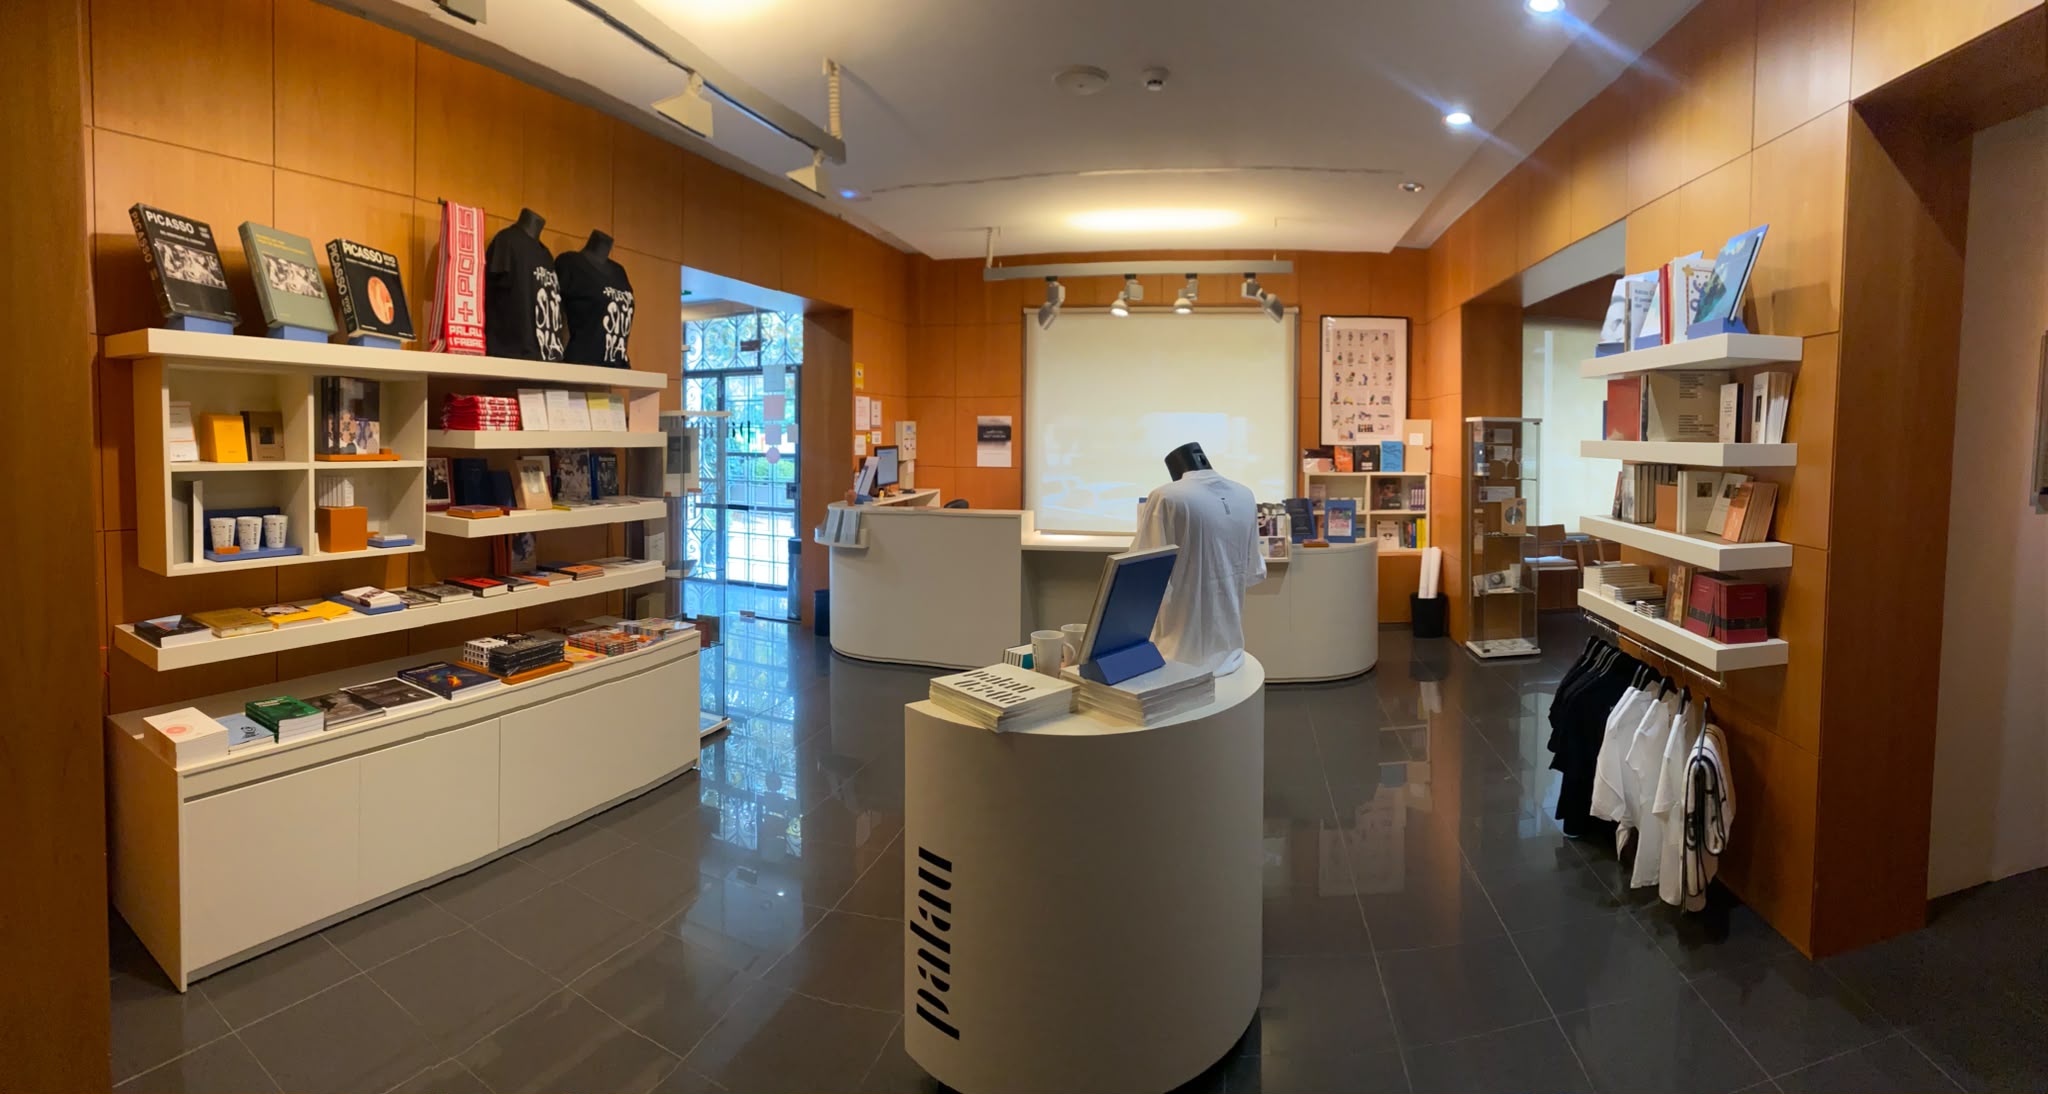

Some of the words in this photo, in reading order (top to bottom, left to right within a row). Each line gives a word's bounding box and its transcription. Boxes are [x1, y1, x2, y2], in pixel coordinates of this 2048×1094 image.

[145, 210, 195, 235] PICASSO
[131, 211, 153, 263] PICASSO
[342, 242, 383, 264] PICASSO
[328, 243, 348, 295] PICASSO
[449, 325, 483, 338] PALAU
[454, 337, 484, 348] FABRE
[910, 846, 960, 1041] palau
